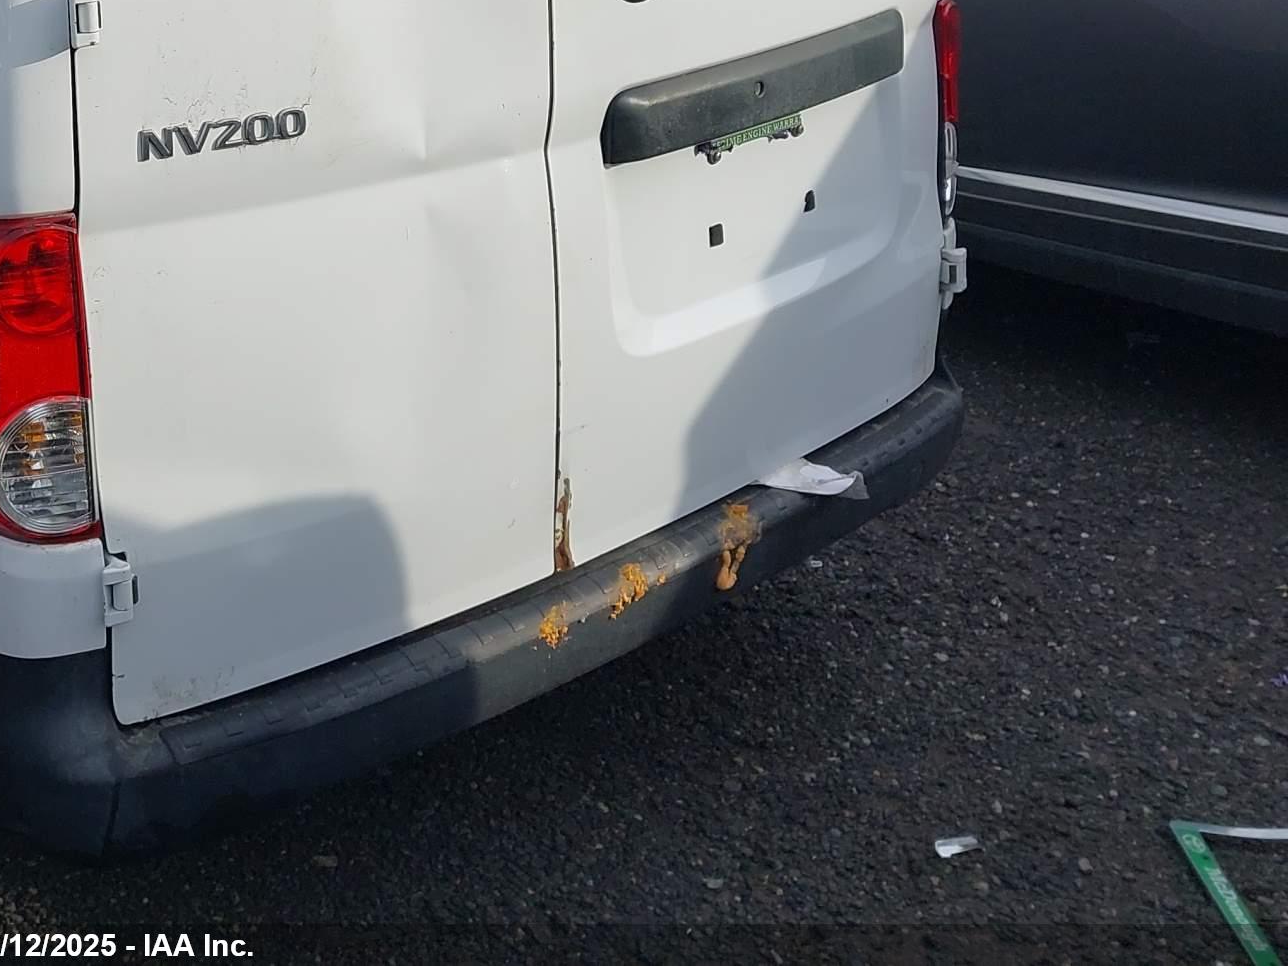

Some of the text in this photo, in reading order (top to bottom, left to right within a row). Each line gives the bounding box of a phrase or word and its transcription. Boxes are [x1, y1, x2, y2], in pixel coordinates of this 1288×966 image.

[136, 108, 307, 162] NV200
[743, 125, 772, 140] ENGINE
[772, 116, 800, 131] WARRA
